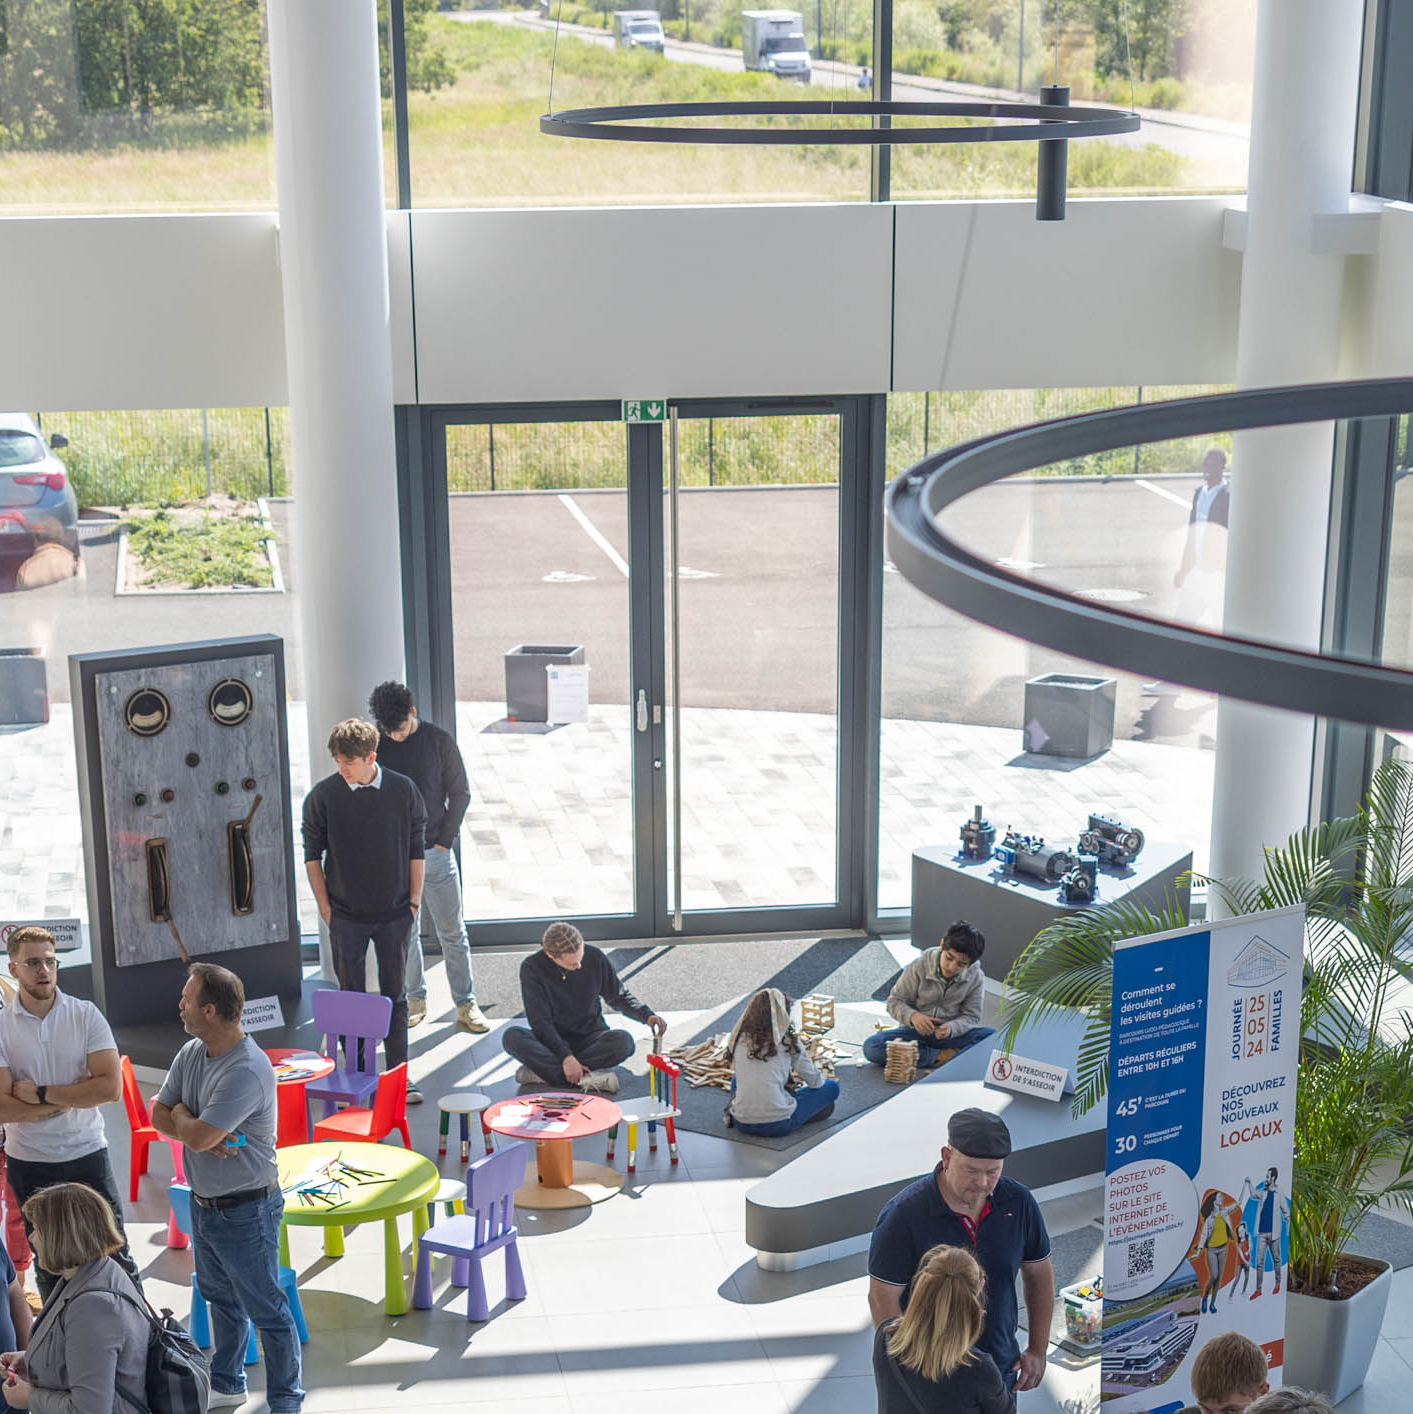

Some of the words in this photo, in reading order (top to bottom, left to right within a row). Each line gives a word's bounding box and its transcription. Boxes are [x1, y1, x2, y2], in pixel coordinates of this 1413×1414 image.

[1121, 984, 1164, 1001] Comment
[1165, 982, 1176, 991] se
[243, 1003, 276, 1015] RDICTION
[1120, 997, 1163, 1013] déroulent
[1120, 1016, 1133, 1026] les
[1133, 1010, 1162, 1023] visites
[1162, 1002, 1196, 1019] guidées
[1196, 999, 1203, 1009] ?
[1249, 994, 1266, 1013] 25
[241, 1014, 275, 1026] S'ASSEOIR
[1231, 997, 1243, 1061] JOURNÉE
[1247, 1016, 1265, 1035] 05
[1271, 989, 1283, 1052] FAMILLES
[1118, 1051, 1155, 1068] DÉPARTS
[1155, 1041, 1197, 1059] RÉGULIERS
[1246, 1039, 1264, 1058] 24
[1015, 1064, 1063, 1083] INTERDICTION
[1117, 1064, 1144, 1078] ENTRE
[1145, 1061, 1160, 1071] 10H
[1161, 1058, 1170, 1068] ET
[1171, 1055, 1185, 1066] 16H
[1012, 1074, 1021, 1083] DE
[1021, 1076, 1056, 1091] S'ASSEOIR
[1222, 1076, 1286, 1101] DÉCOUVREZ
[1144, 1099, 1170, 1109] PARCOURS
[1221, 1098, 1244, 1113] NOS
[1221, 1101, 1280, 1125] NOUVEAUX
[1220, 1119, 1283, 1149] LOCAUX
[1114, 1134, 1137, 1154] 30
[1110, 1170, 1147, 1187] POSTEZ
[1148, 1165, 1167, 1178] VOS
[1109, 1182, 1149, 1199] PHOTOS
[1109, 1200, 1129, 1213] SUR
[1130, 1196, 1142, 1208] LE
[1143, 1191, 1163, 1204] SITE
[1109, 1206, 1156, 1225] INTERNET
[1155, 1202, 1168, 1213] DE
